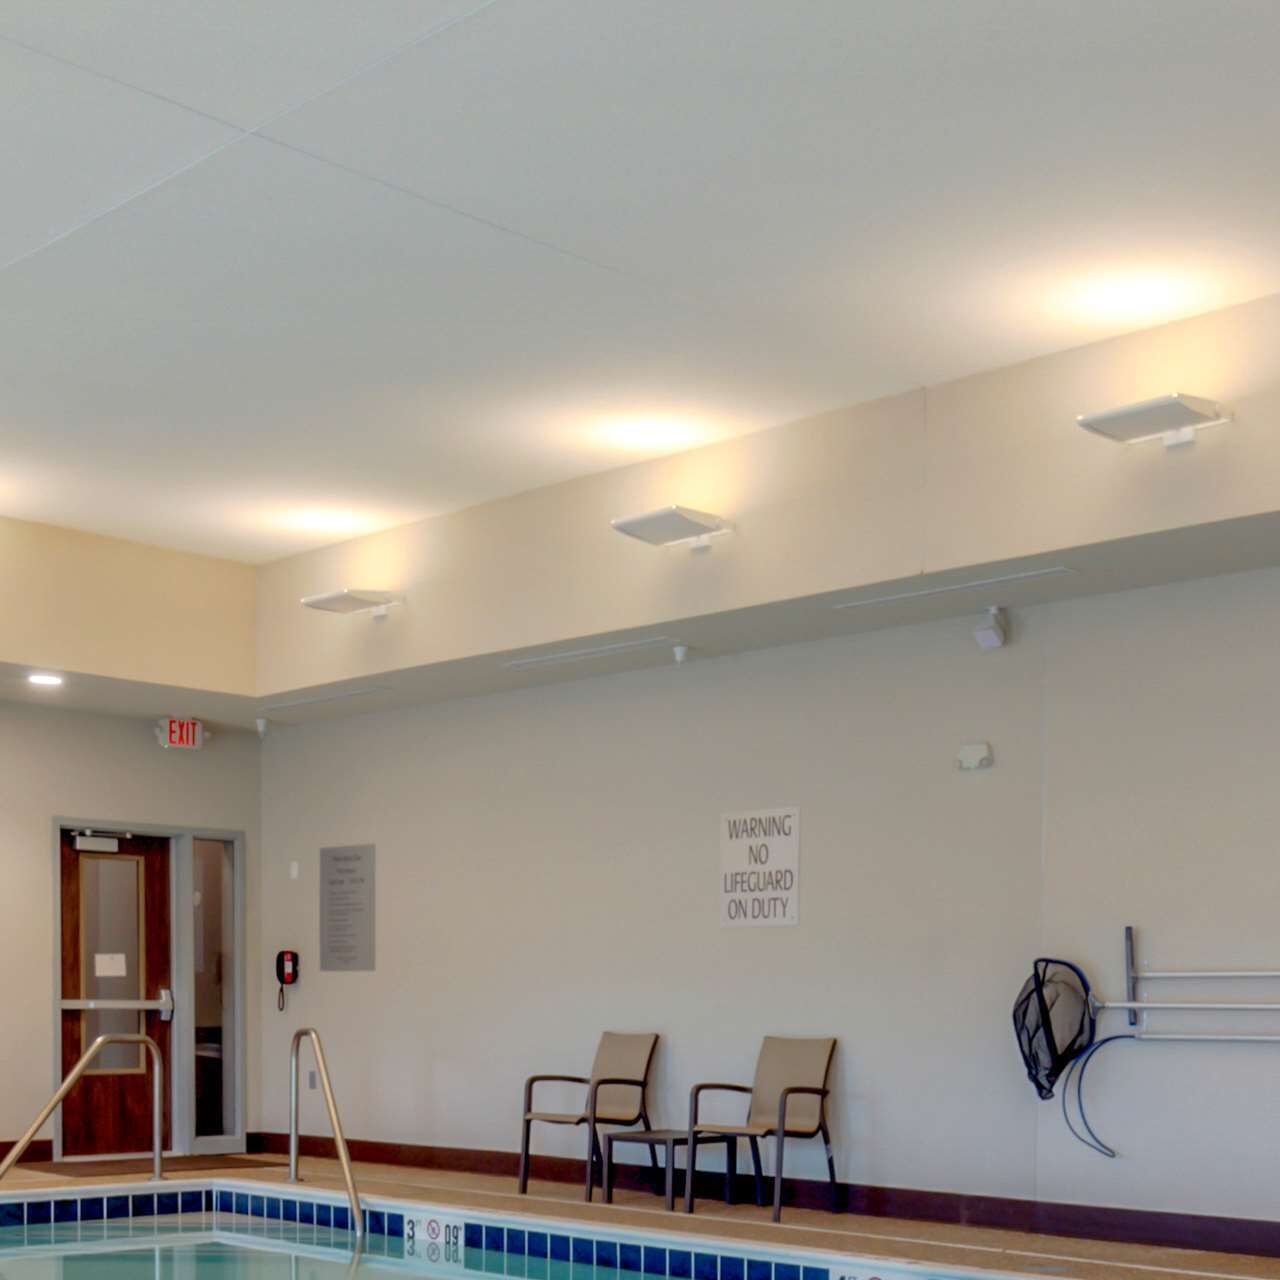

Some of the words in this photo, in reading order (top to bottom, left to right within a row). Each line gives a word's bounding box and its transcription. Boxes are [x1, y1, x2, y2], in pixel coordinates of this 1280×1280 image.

[168, 718, 198, 747] EXIT
[727, 814, 793, 840] WARNING
[748, 843, 770, 865] NO
[723, 869, 794, 893] LIFEGUARD
[727, 898, 748, 920] ON
[751, 897, 790, 919] DUTY
[407, 1219, 416, 1240] 3
